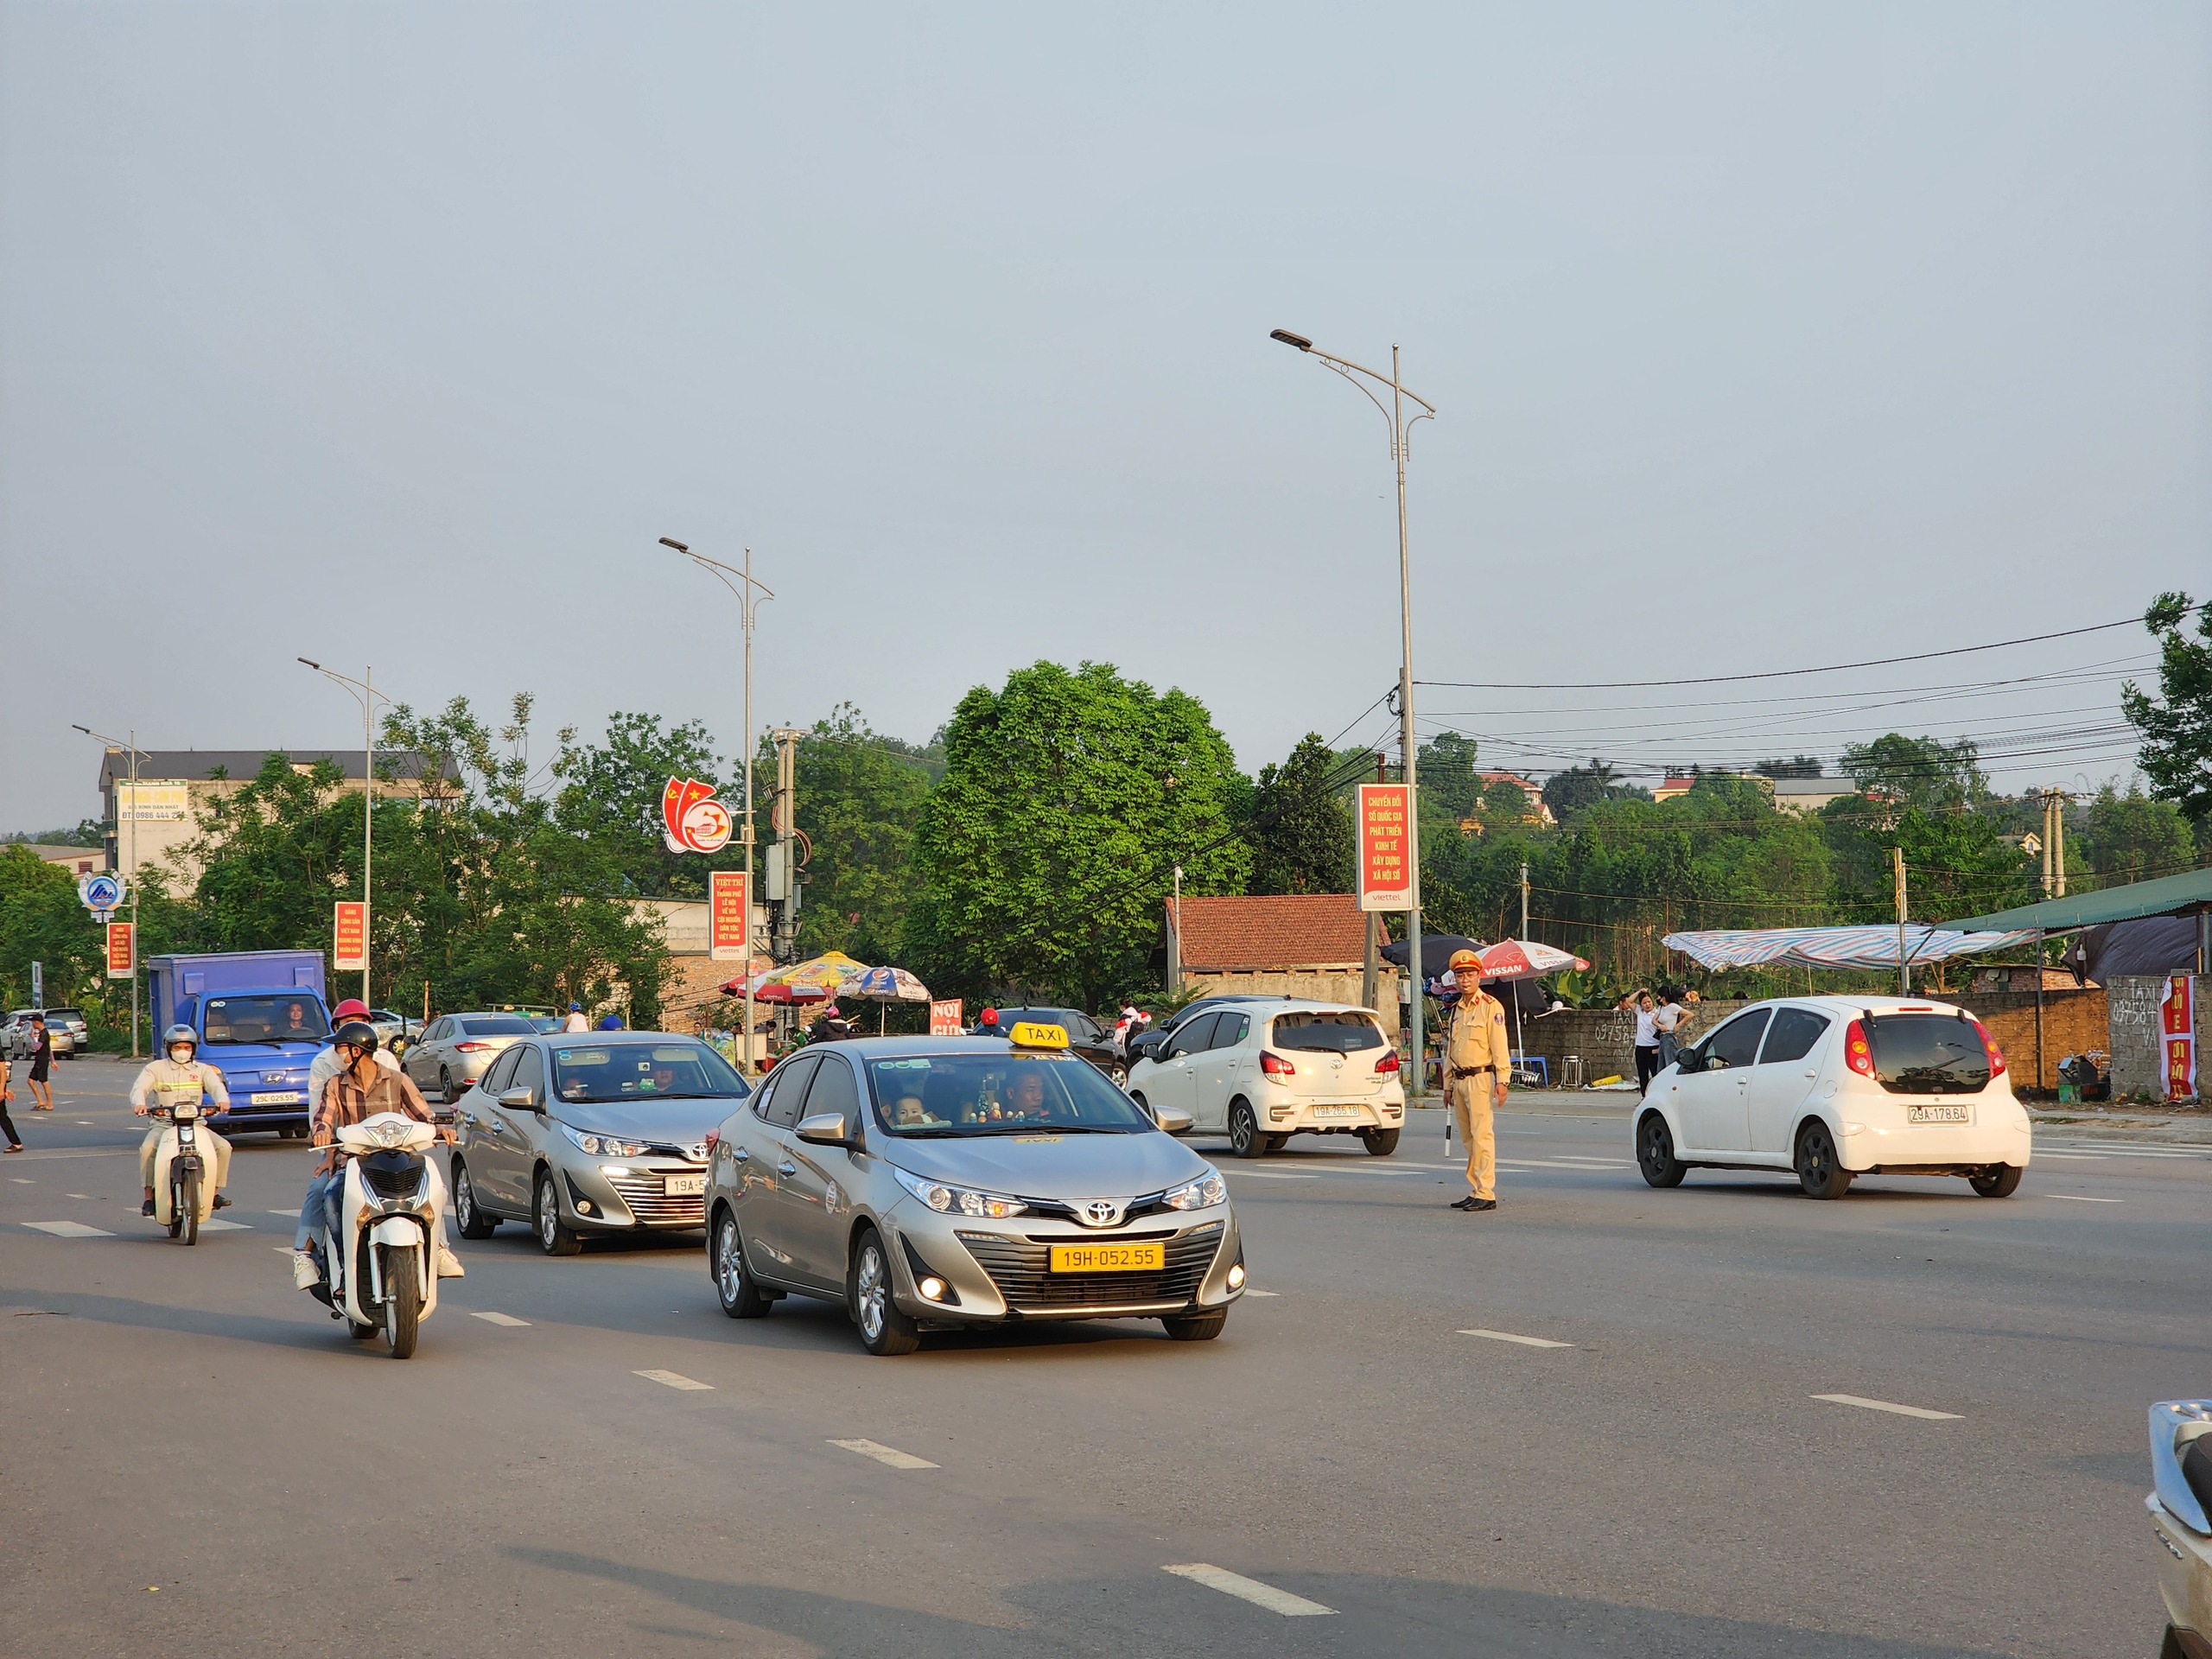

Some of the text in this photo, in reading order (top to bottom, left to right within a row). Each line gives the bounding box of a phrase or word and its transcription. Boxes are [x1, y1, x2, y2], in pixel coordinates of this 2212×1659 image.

[1368, 793, 1402, 807] CHUYỂN ĐỔI
[1368, 809, 1402, 822] SỐ QUỐC GIA
[1370, 823, 1402, 836] PHÁT TRIỂN
[1375, 839, 1397, 851] KINH TẾ
[1372, 854, 1401, 868] XÂY DỰNG
[715, 876, 744, 887] VIỆT TRÌ
[1373, 868, 1401, 882] XÃ HỘI SỐ
[718, 932, 728, 941] VIỆT
[1484, 964, 1522, 976] VISSAN
[2129, 978, 2156, 1002] TAXI
[933, 1002, 960, 1019] NƠI
[1025, 1027, 1062, 1042] TAXI
[1316, 1105, 1358, 1116] 19A-265.18
[1910, 1108, 1967, 1121] 29A-178.64
[674, 1179, 705, 1192] 19A-5
[1064, 1249, 1154, 1267] 19H-052.55
